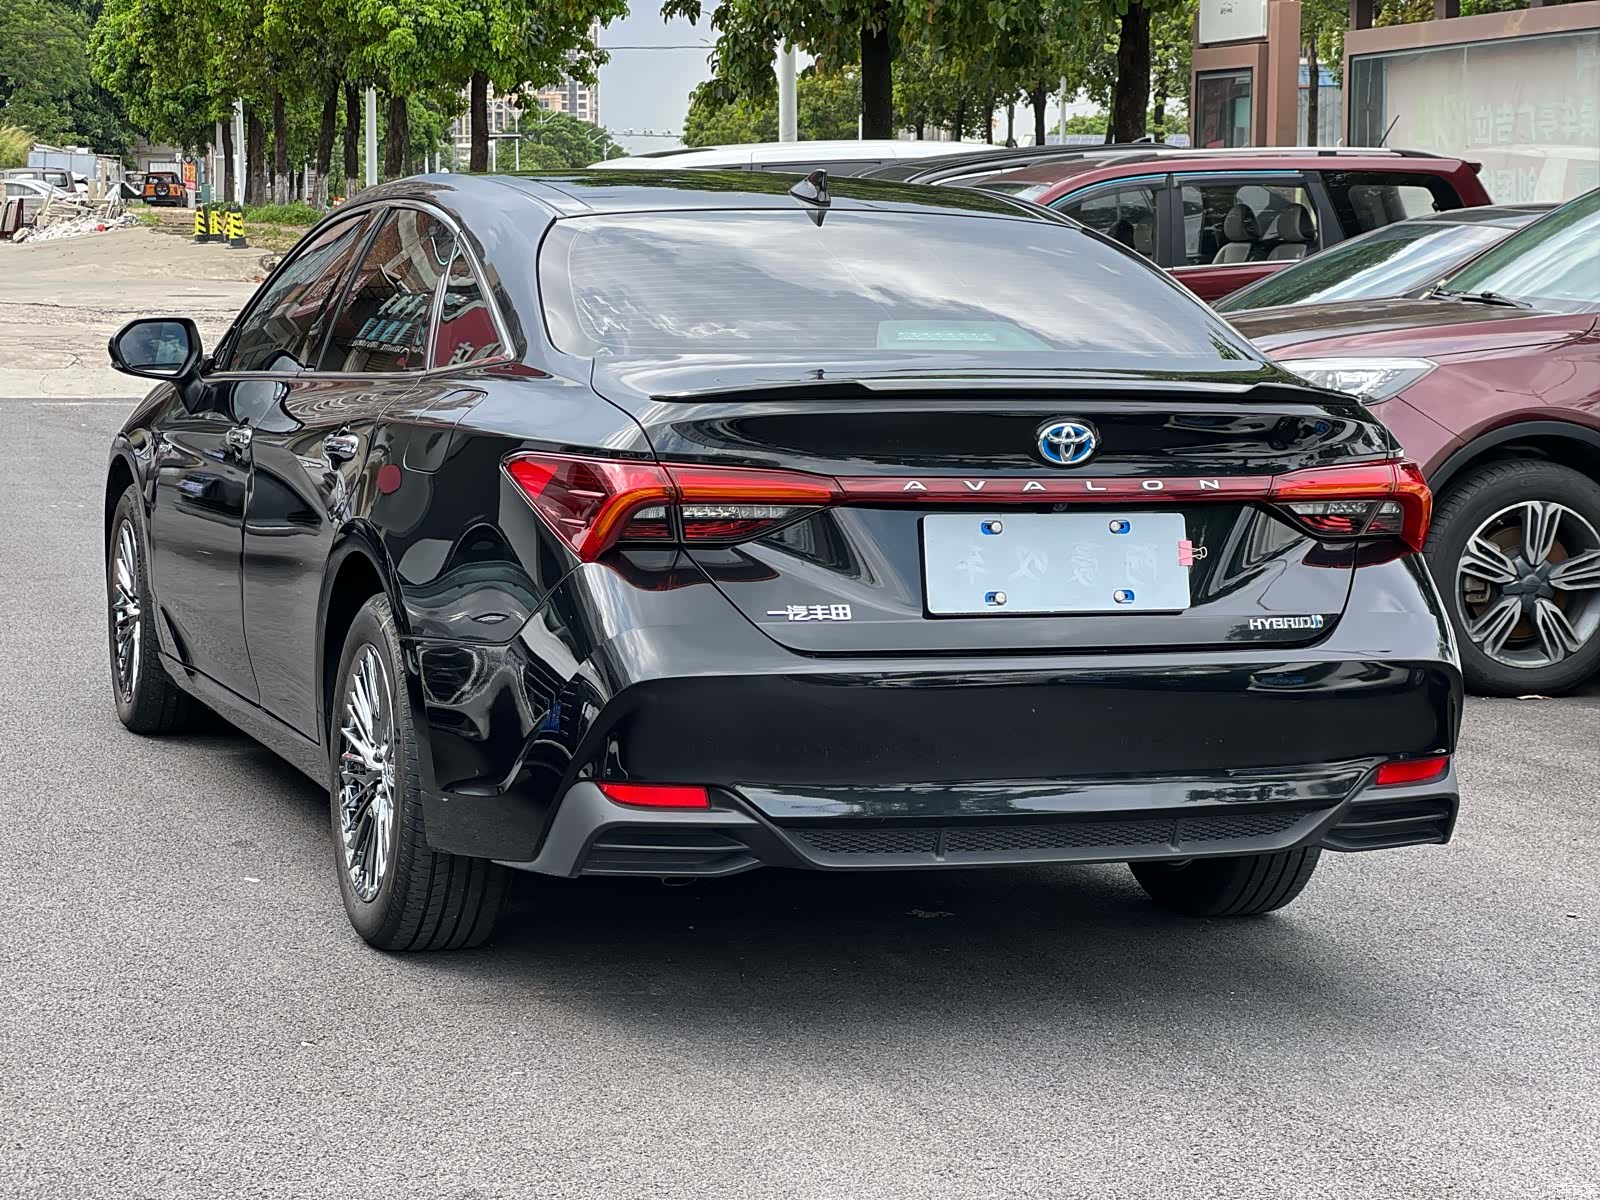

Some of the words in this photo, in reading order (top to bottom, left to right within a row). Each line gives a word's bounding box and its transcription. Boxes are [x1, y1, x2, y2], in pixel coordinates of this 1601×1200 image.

[902, 479, 1221, 492] AVALON
[766, 604, 852, 621] 一汽丰田
[1249, 616, 1312, 630] HYBRID
